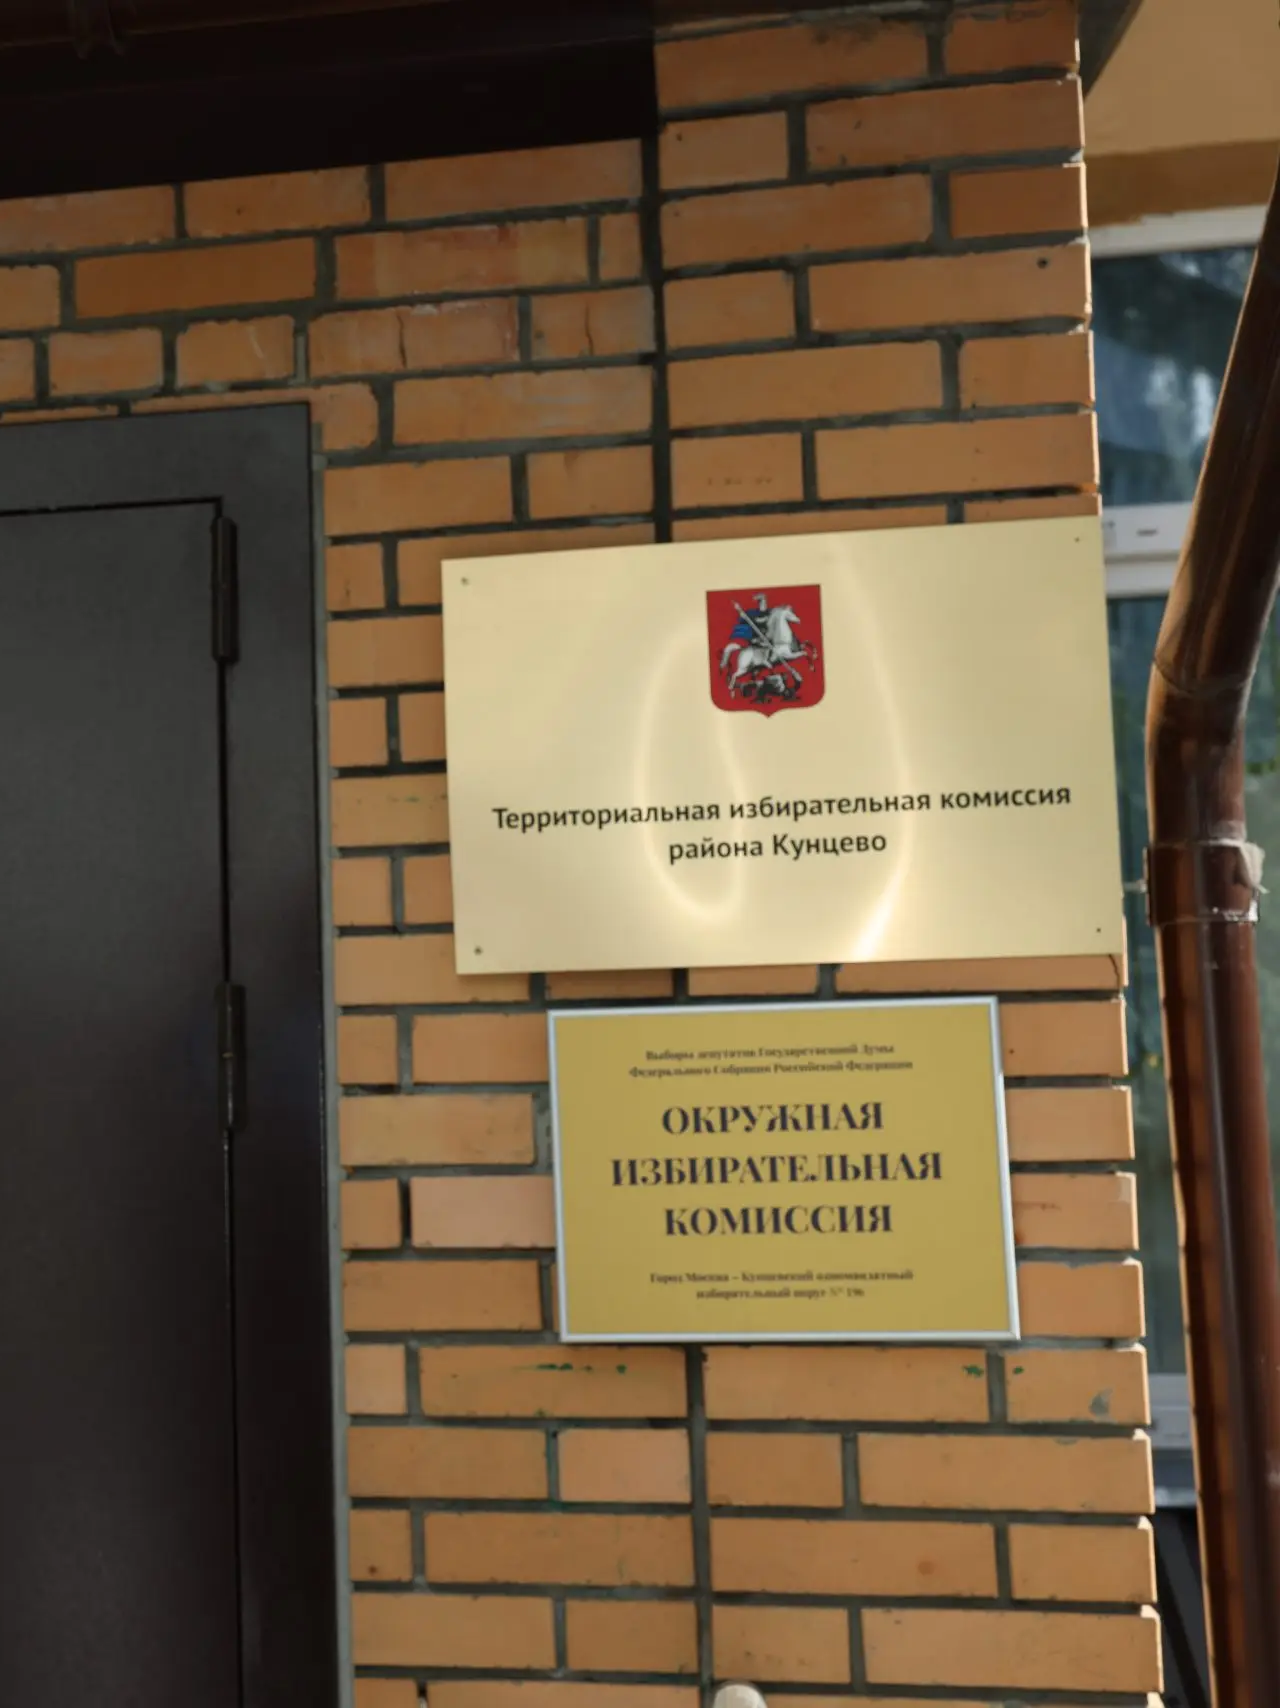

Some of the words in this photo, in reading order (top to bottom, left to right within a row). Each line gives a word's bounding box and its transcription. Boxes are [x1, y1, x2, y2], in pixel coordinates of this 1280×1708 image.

[491, 803, 721, 832] Территориальная
[728, 794, 931, 822] избирательная
[940, 786, 1071, 809] комиссия
[668, 838, 764, 865] района
[772, 832, 888, 860] Кунцево
[661, 1101, 884, 1134] ОКРУЖНАЯ
[611, 1152, 943, 1187] ИЗБИРАТЕЛЬНАЯ
[664, 1204, 893, 1237] КОМИССИЯ
